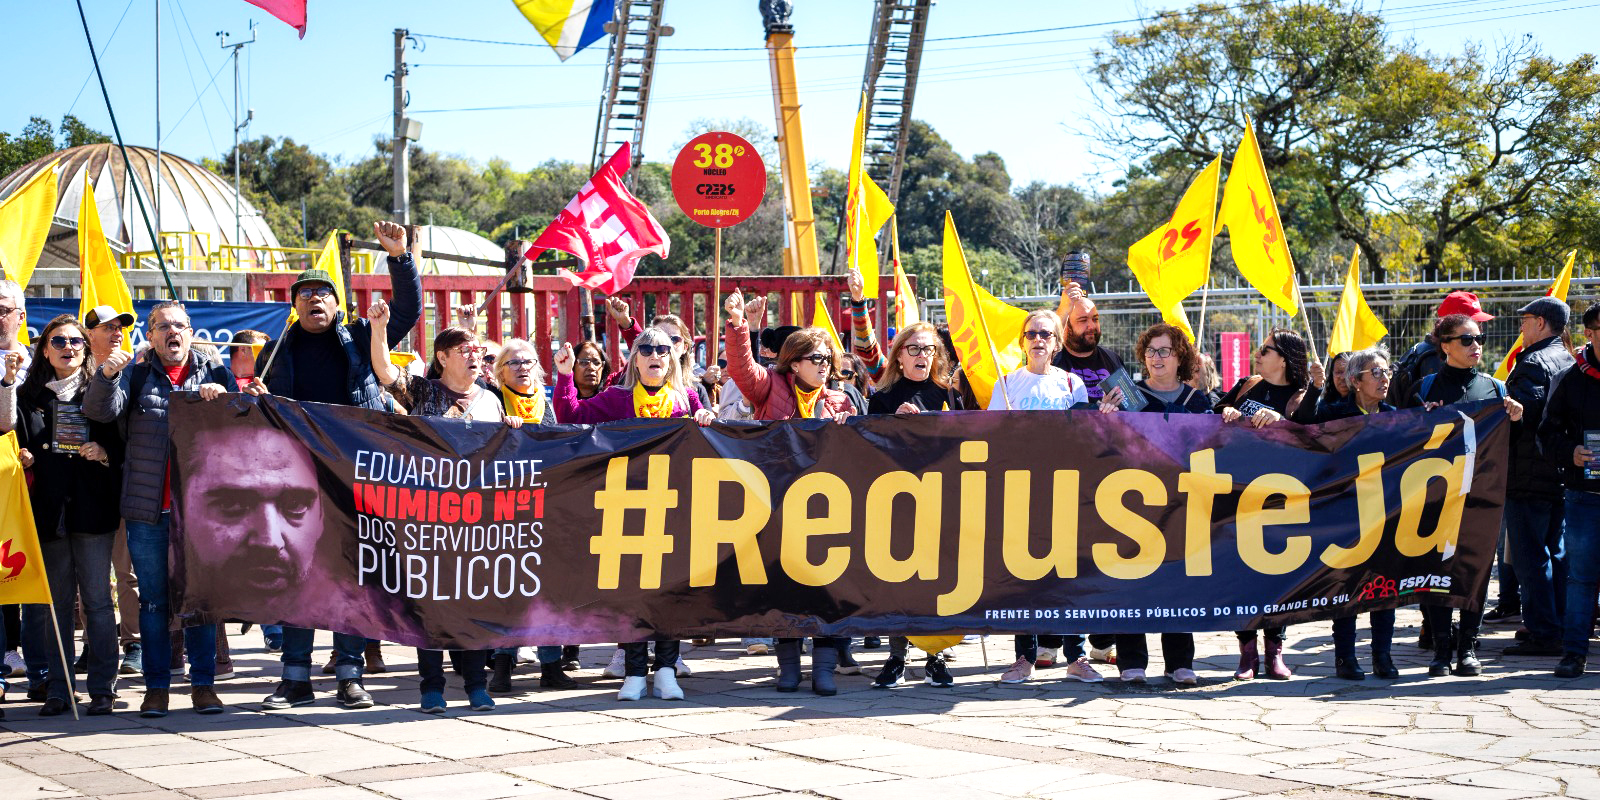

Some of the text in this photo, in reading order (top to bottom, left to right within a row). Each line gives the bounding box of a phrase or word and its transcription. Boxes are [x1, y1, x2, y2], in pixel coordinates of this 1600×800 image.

[703, 168, 727, 176] NÚCLEO
[696, 184, 736, 195] CPERS
[693, 208, 710, 216] Porto
[354, 449, 548, 490] EDUARDO LEITE,
[352, 482, 545, 524] INIMIGO Nº1
[357, 513, 544, 552] DOS SERVIDORES
[358, 542, 542, 601] PÚBLICOS
[1398, 573, 1452, 591] FSP/RS
[985, 593, 1350, 619] FRENTE DOS SERVIDORES PÚBLICOS DO RIO GRANDE DO SUL
